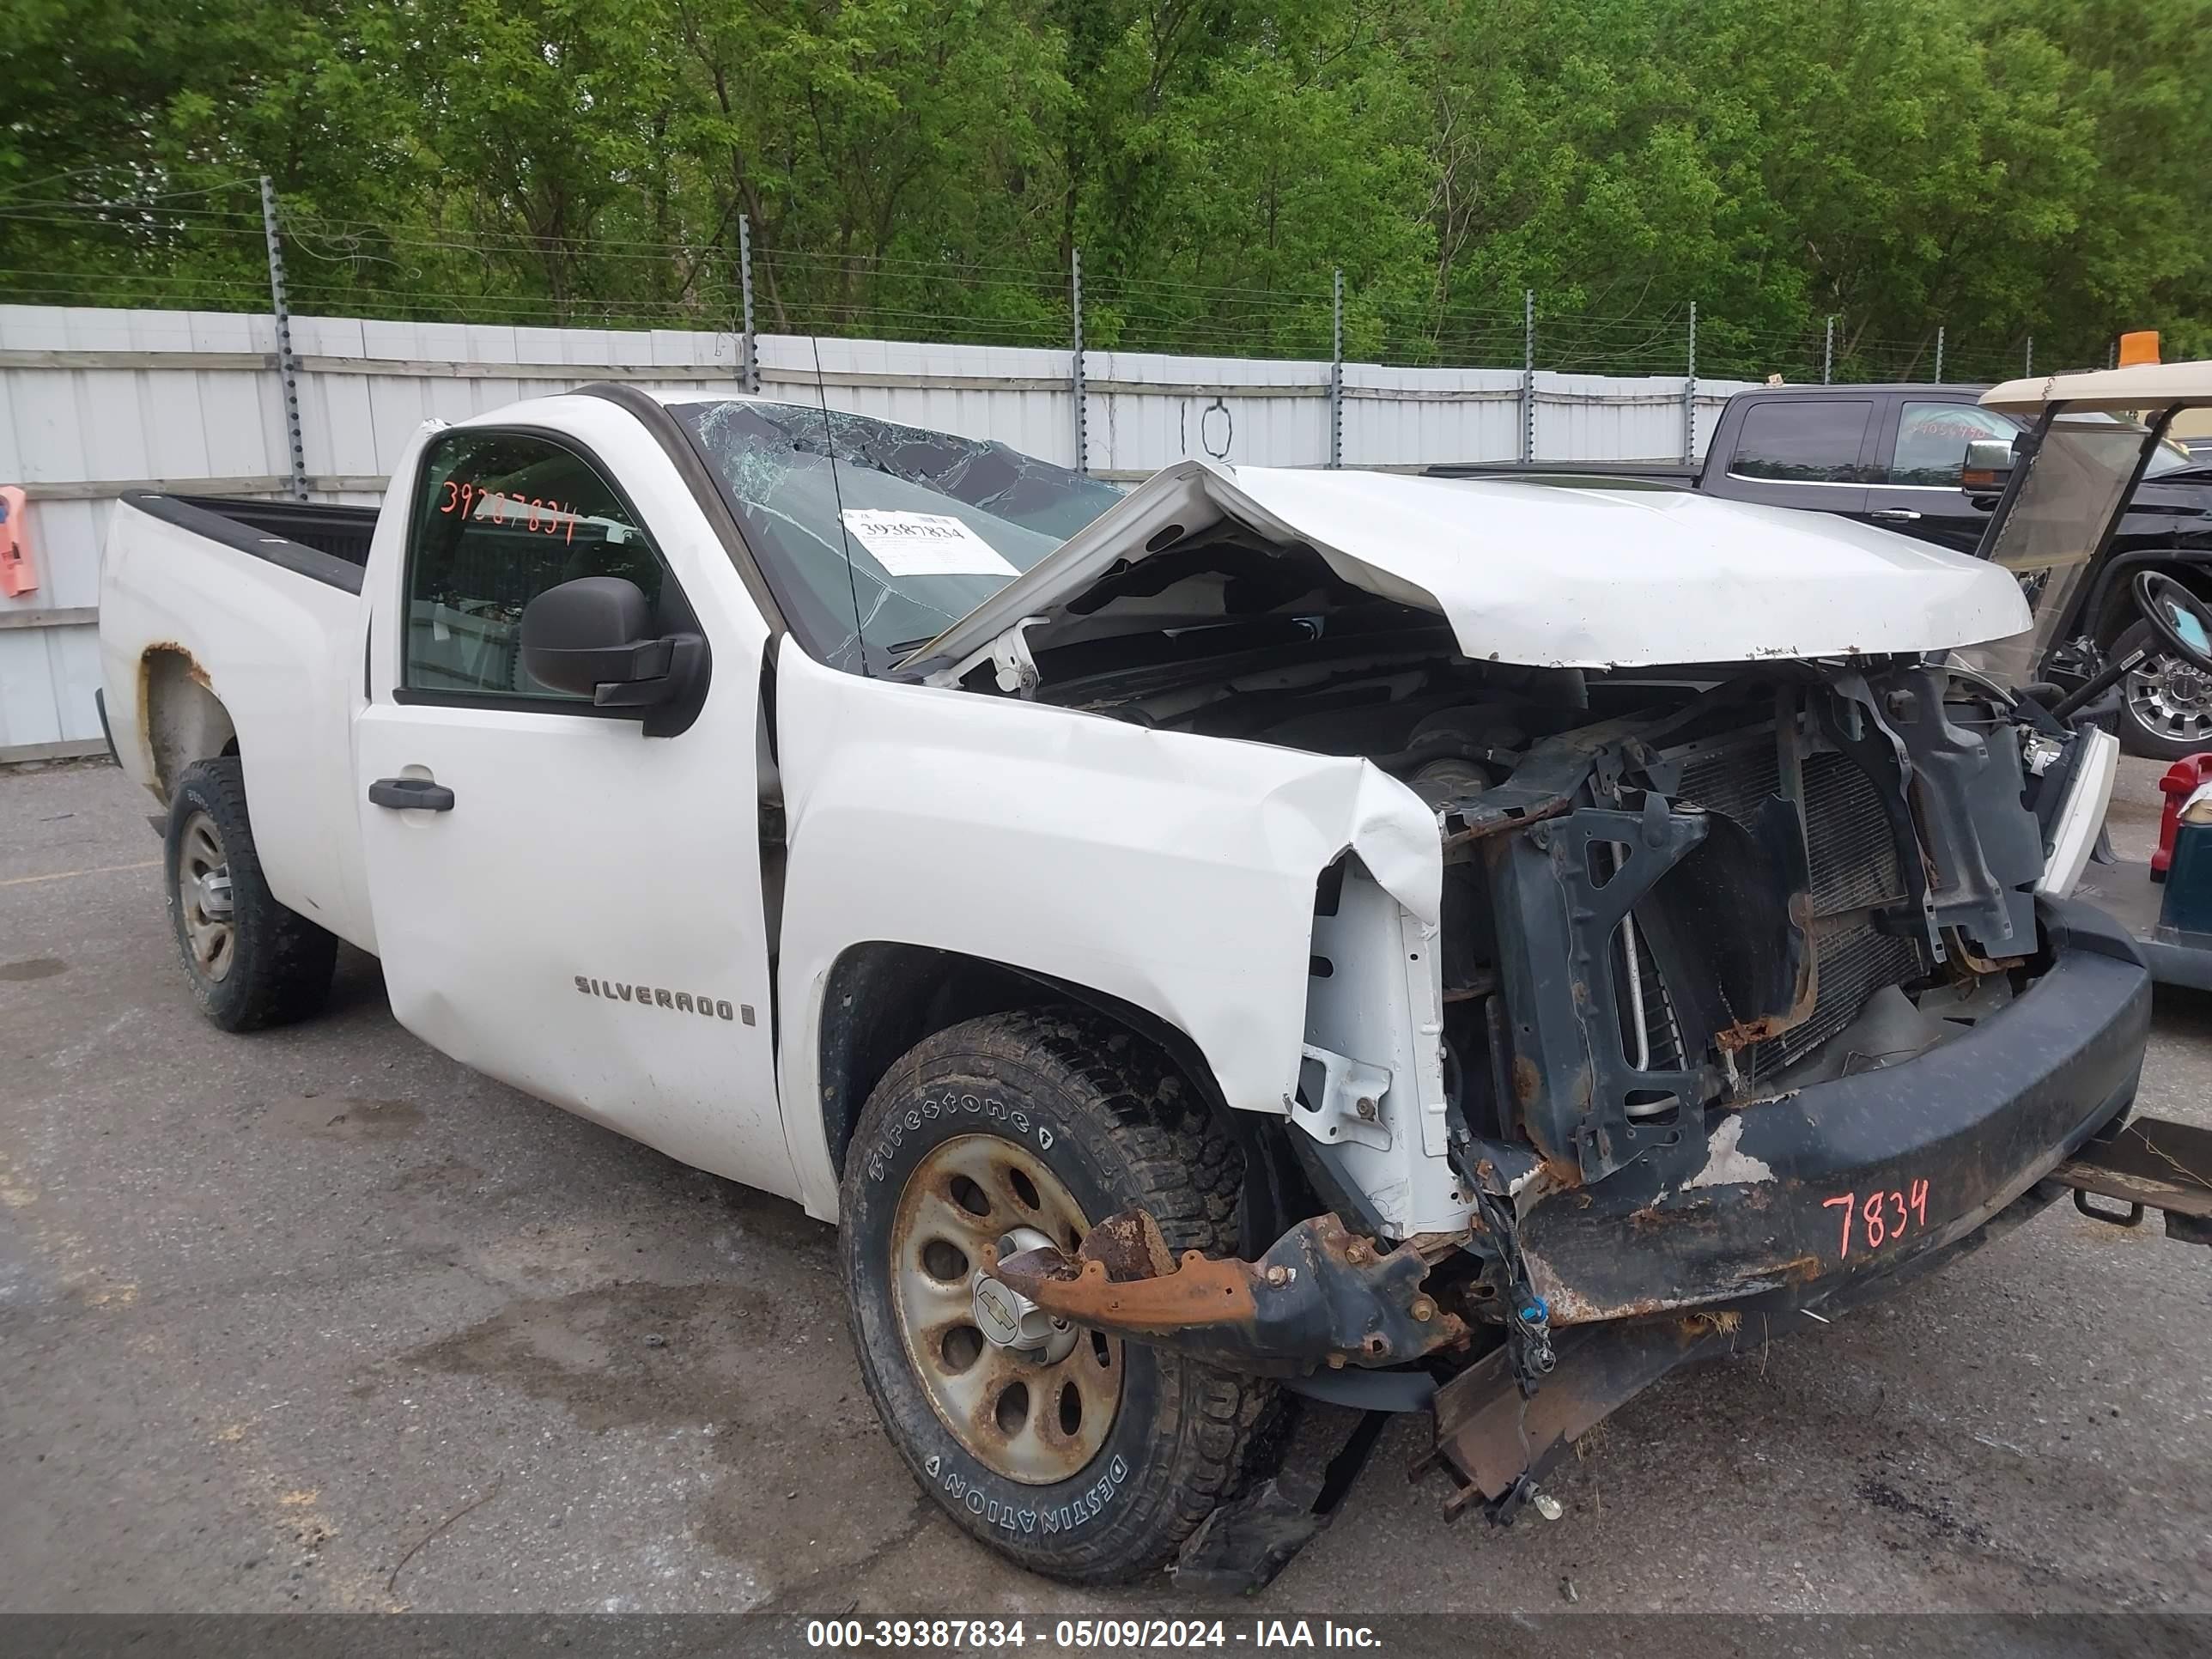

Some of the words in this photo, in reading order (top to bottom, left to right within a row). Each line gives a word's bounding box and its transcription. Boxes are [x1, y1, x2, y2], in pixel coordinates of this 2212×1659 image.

[440, 481, 578, 546] 39387834
[860, 522, 966, 540] 39387834
[574, 975, 733, 1020] SILVERADO
[868, 1091, 1030, 1182] Firestone
[1822, 1179, 1929, 1261] 7834
[945, 1454, 1128, 1534] DESTINATION
